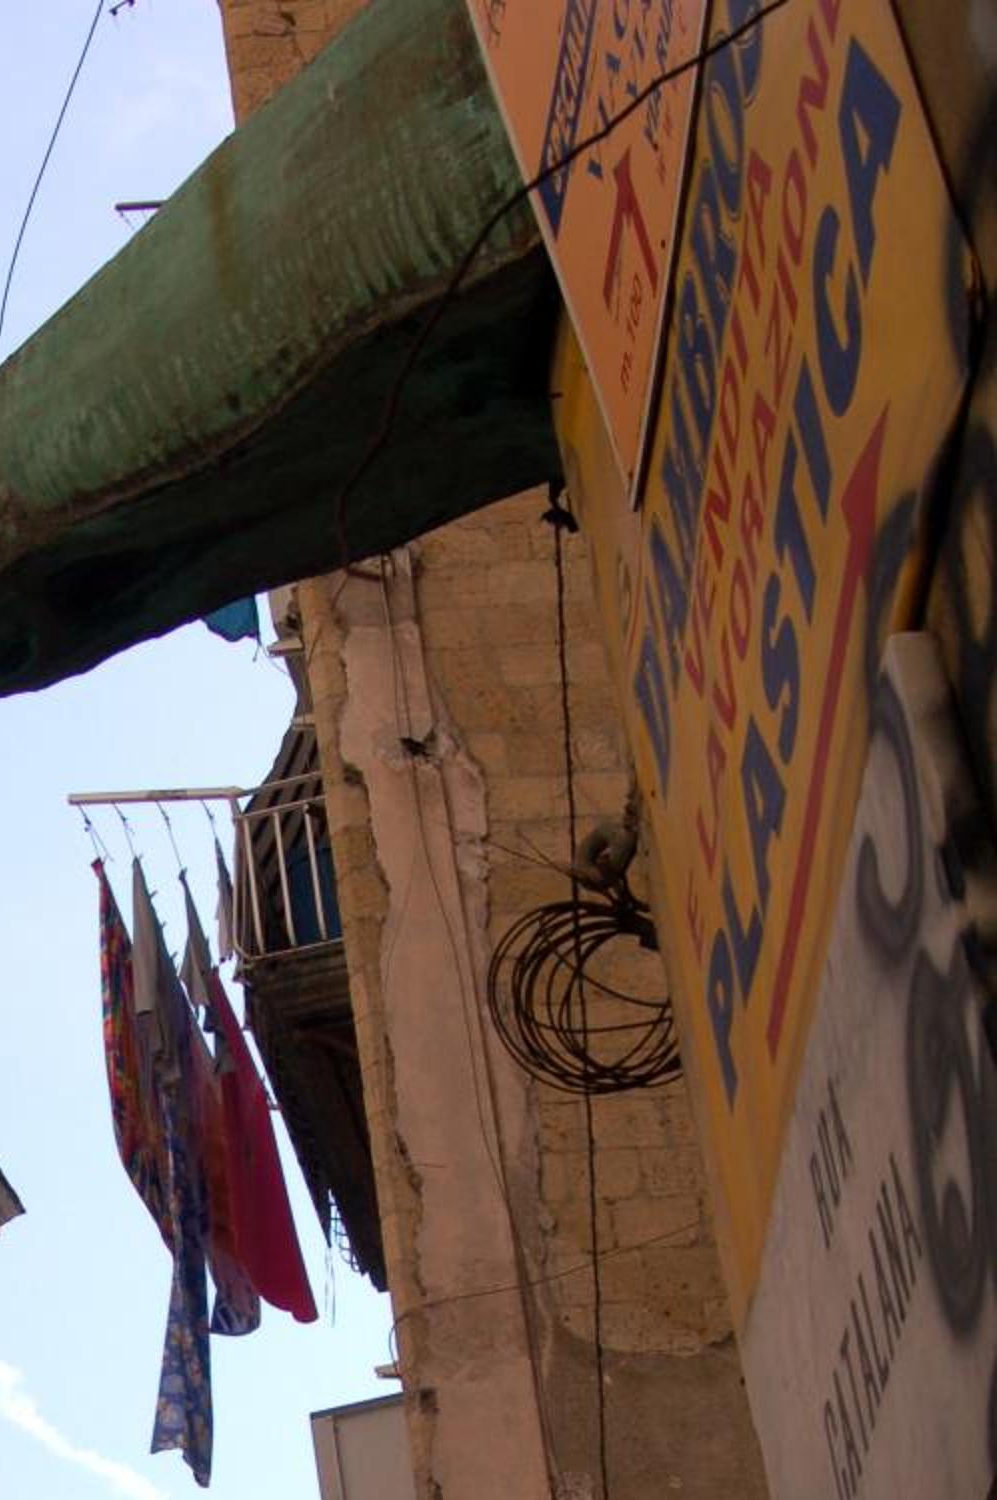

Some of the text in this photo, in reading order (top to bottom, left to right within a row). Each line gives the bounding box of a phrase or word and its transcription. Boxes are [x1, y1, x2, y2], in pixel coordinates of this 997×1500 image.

[685, 148, 773, 698] VENDITA
[706, 35, 900, 1112] PLASTICA
[684, 866, 702, 963] E
[809, 1077, 852, 1250] RUA
